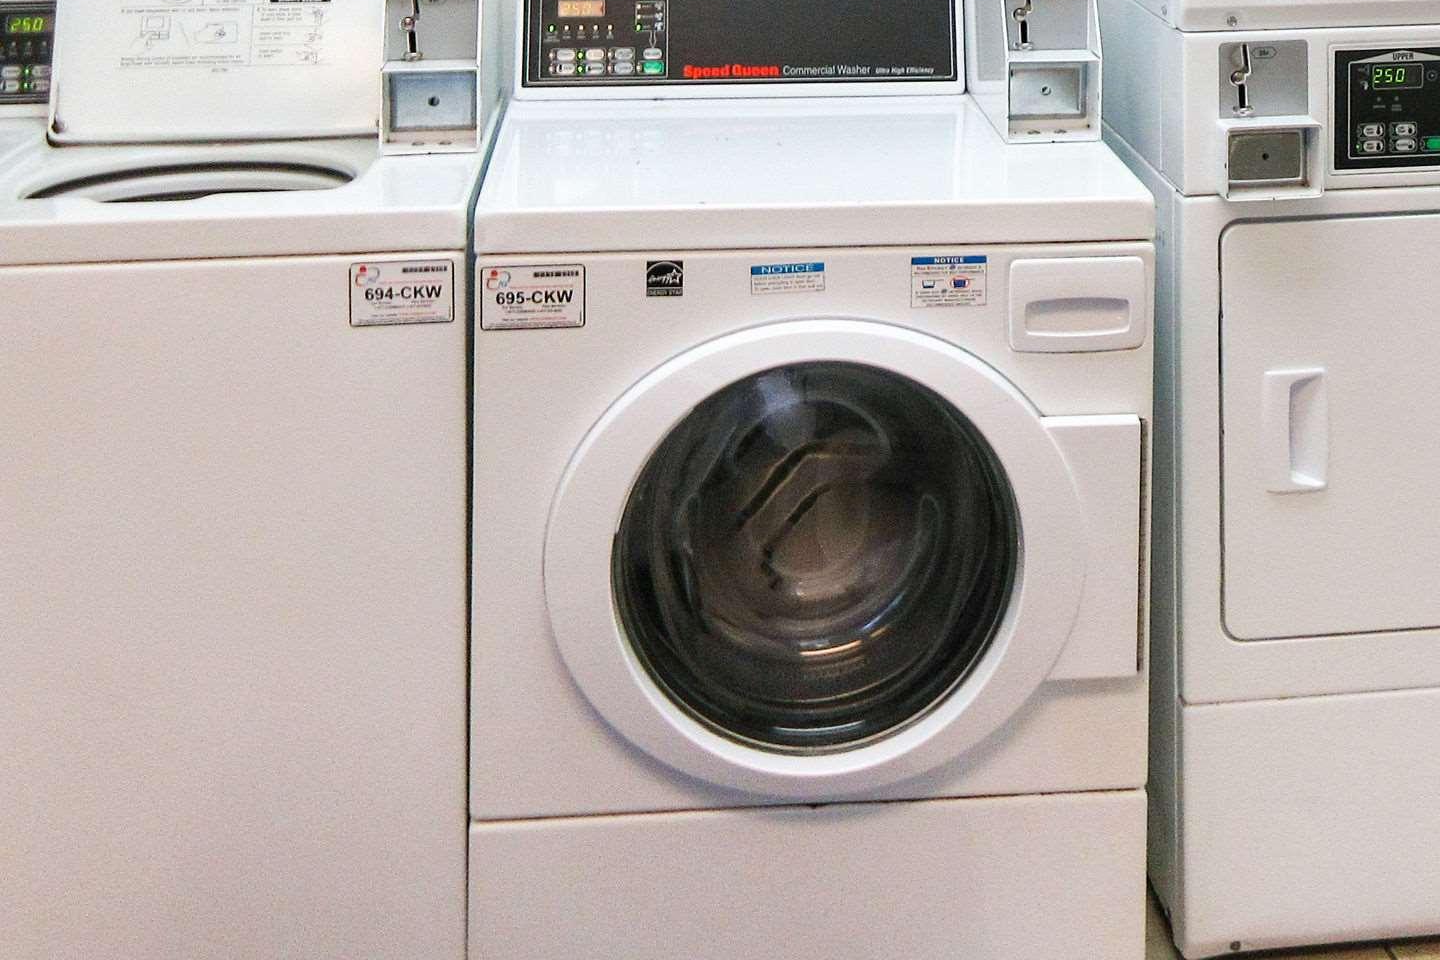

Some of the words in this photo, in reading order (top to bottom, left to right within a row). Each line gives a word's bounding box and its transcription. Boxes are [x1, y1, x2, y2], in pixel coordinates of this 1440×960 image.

[1392, 52, 1414, 60] UPPER
[683, 64, 731, 79] Speed
[732, 64, 780, 76] Queen
[783, 65, 835, 77] Commercial
[837, 65, 871, 75] Washer
[1373, 68, 1405, 83] 250
[761, 264, 815, 273] NOTICE
[365, 285, 442, 301] 694-CKW
[496, 290, 573, 305] 695-CKW
